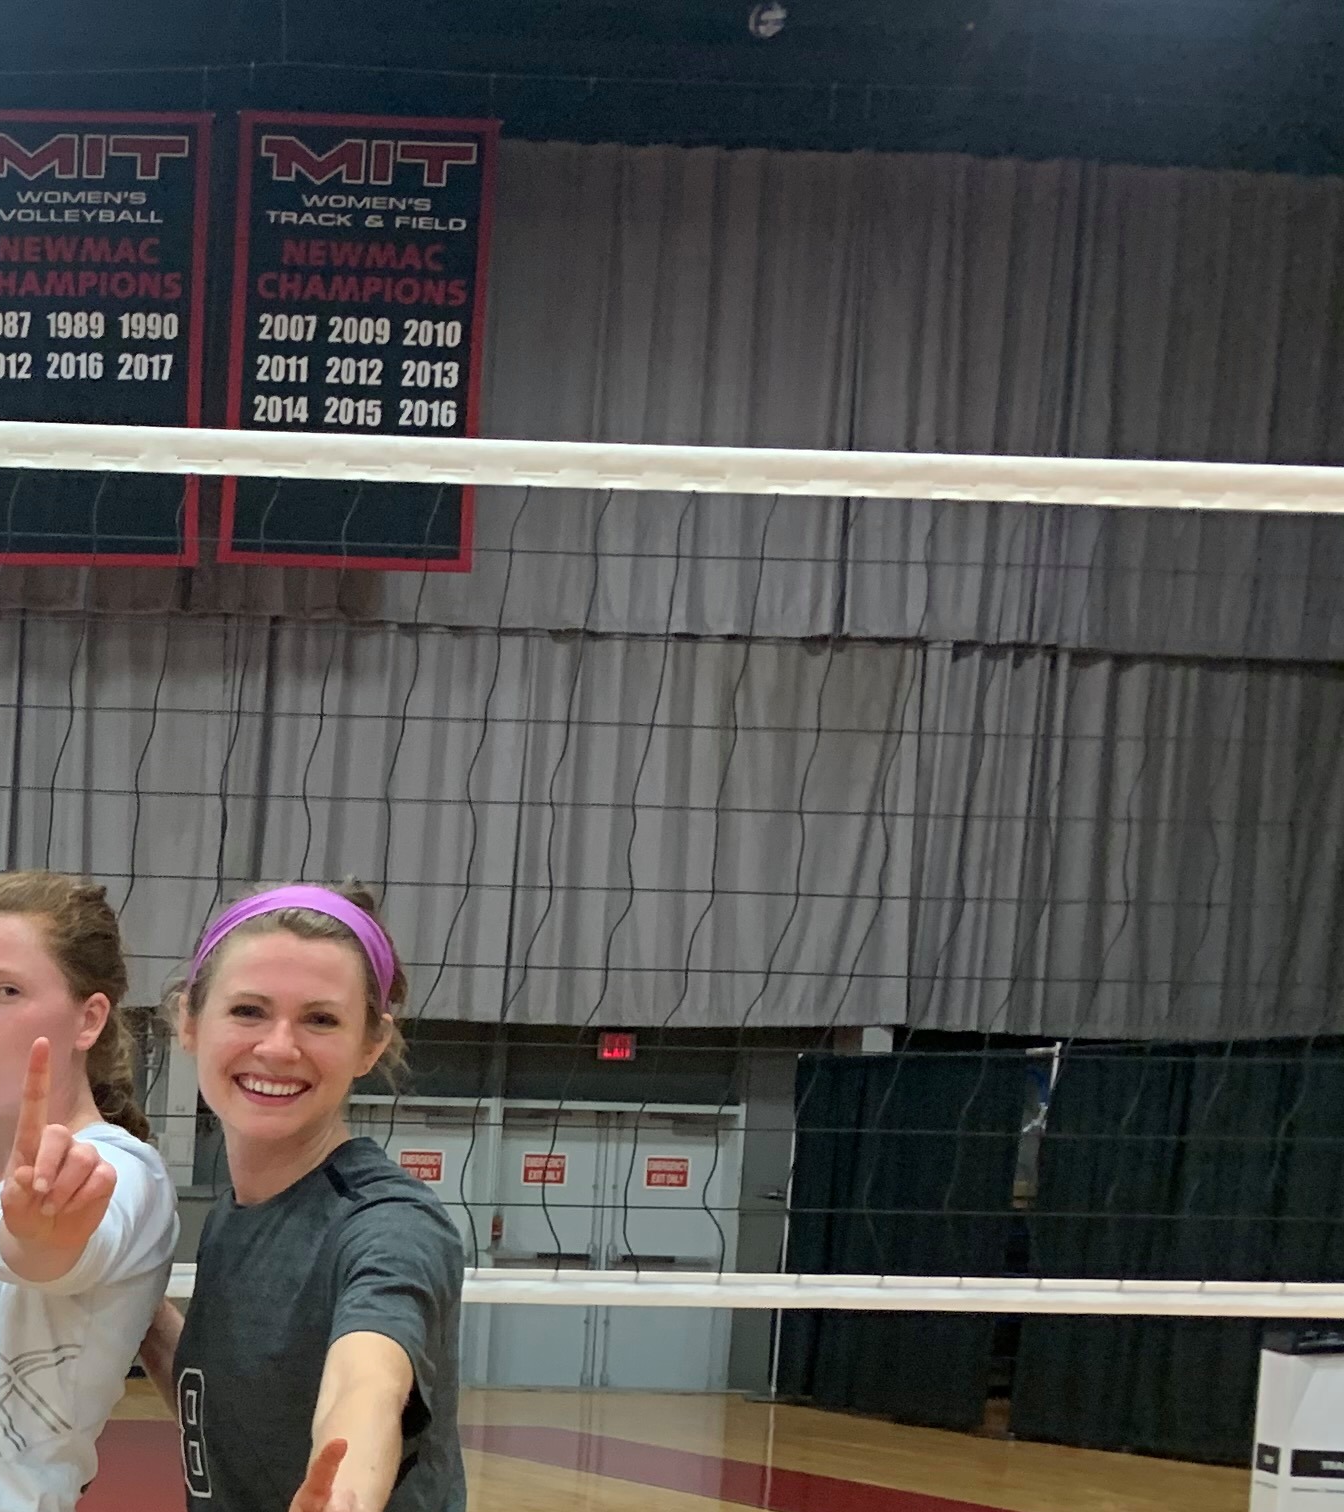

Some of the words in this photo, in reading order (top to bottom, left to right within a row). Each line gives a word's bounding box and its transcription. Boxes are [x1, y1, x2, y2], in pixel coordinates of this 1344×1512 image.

[261, 136, 477, 187] MIT
[16, 190, 147, 205] WOMEN'S
[302, 194, 431, 211] WOMEN'S
[266, 210, 352, 228] TRACK
[365, 215, 384, 228] &
[395, 215, 466, 232] FIELD
[282, 240, 446, 271] NEWMAC
[257, 273, 467, 307] CHAMPIONS
[46, 312, 105, 340] 1989
[118, 312, 179, 340] 1990
[258, 314, 317, 342] 2007
[328, 316, 390, 345] 2009
[403, 319, 462, 348] 2010
[46, 353, 104, 380] 2016
[117, 354, 174, 381] 2017
[256, 355, 309, 383] 2011
[325, 357, 383, 386] 2012
[401, 360, 459, 388] 2013
[254, 395, 309, 424] 2014
[323, 397, 382, 427] 2015
[398, 399, 457, 428] 2016
